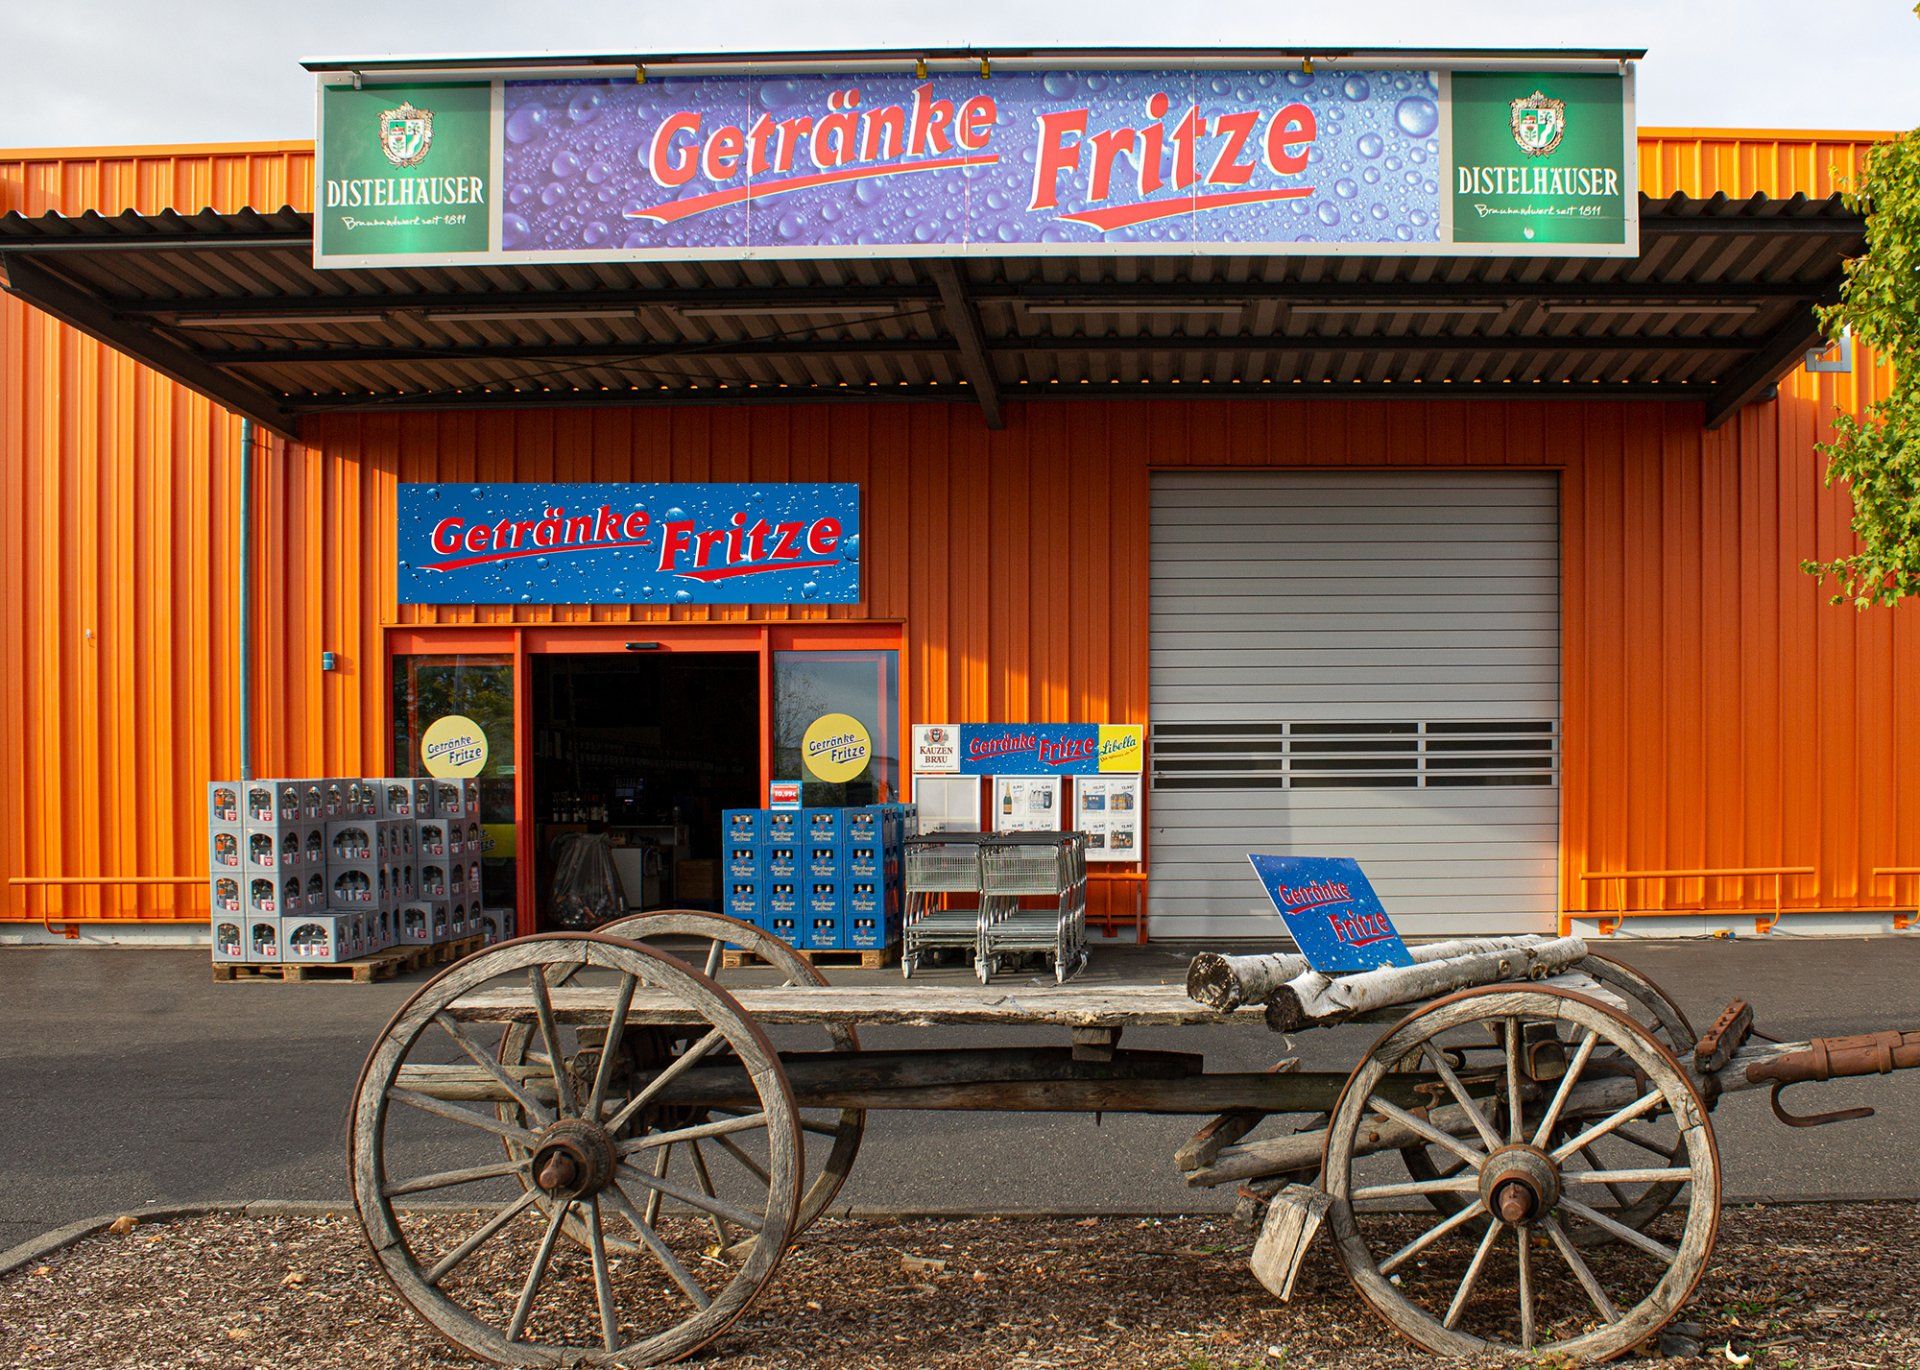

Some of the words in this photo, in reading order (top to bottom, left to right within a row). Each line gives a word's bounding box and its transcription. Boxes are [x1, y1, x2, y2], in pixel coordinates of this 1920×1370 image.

[647, 82, 998, 188] Getränke
[1026, 92, 1318, 212] Fritze
[1458, 166, 1619, 196] DISTELHÄUSER
[326, 176, 485, 208] DISTELHÄUSER
[443, 214, 467, 226] 1811
[1578, 204, 1601, 217] 1811
[429, 503, 651, 556] Getränke
[657, 511, 842, 572] Fritze
[427, 736, 472, 754] Getränke
[809, 733, 855, 752] Getränke
[919, 746, 953, 755] KAUZEN
[969, 732, 1037, 757] Getränke
[1038, 735, 1095, 762] Fritze
[1100, 735, 1136, 755] Libella
[448, 747, 482, 764] Fritze
[831, 745, 865, 762] Fritze
[1278, 879, 1352, 906] Getränke
[1326, 910, 1390, 943] Fritze
